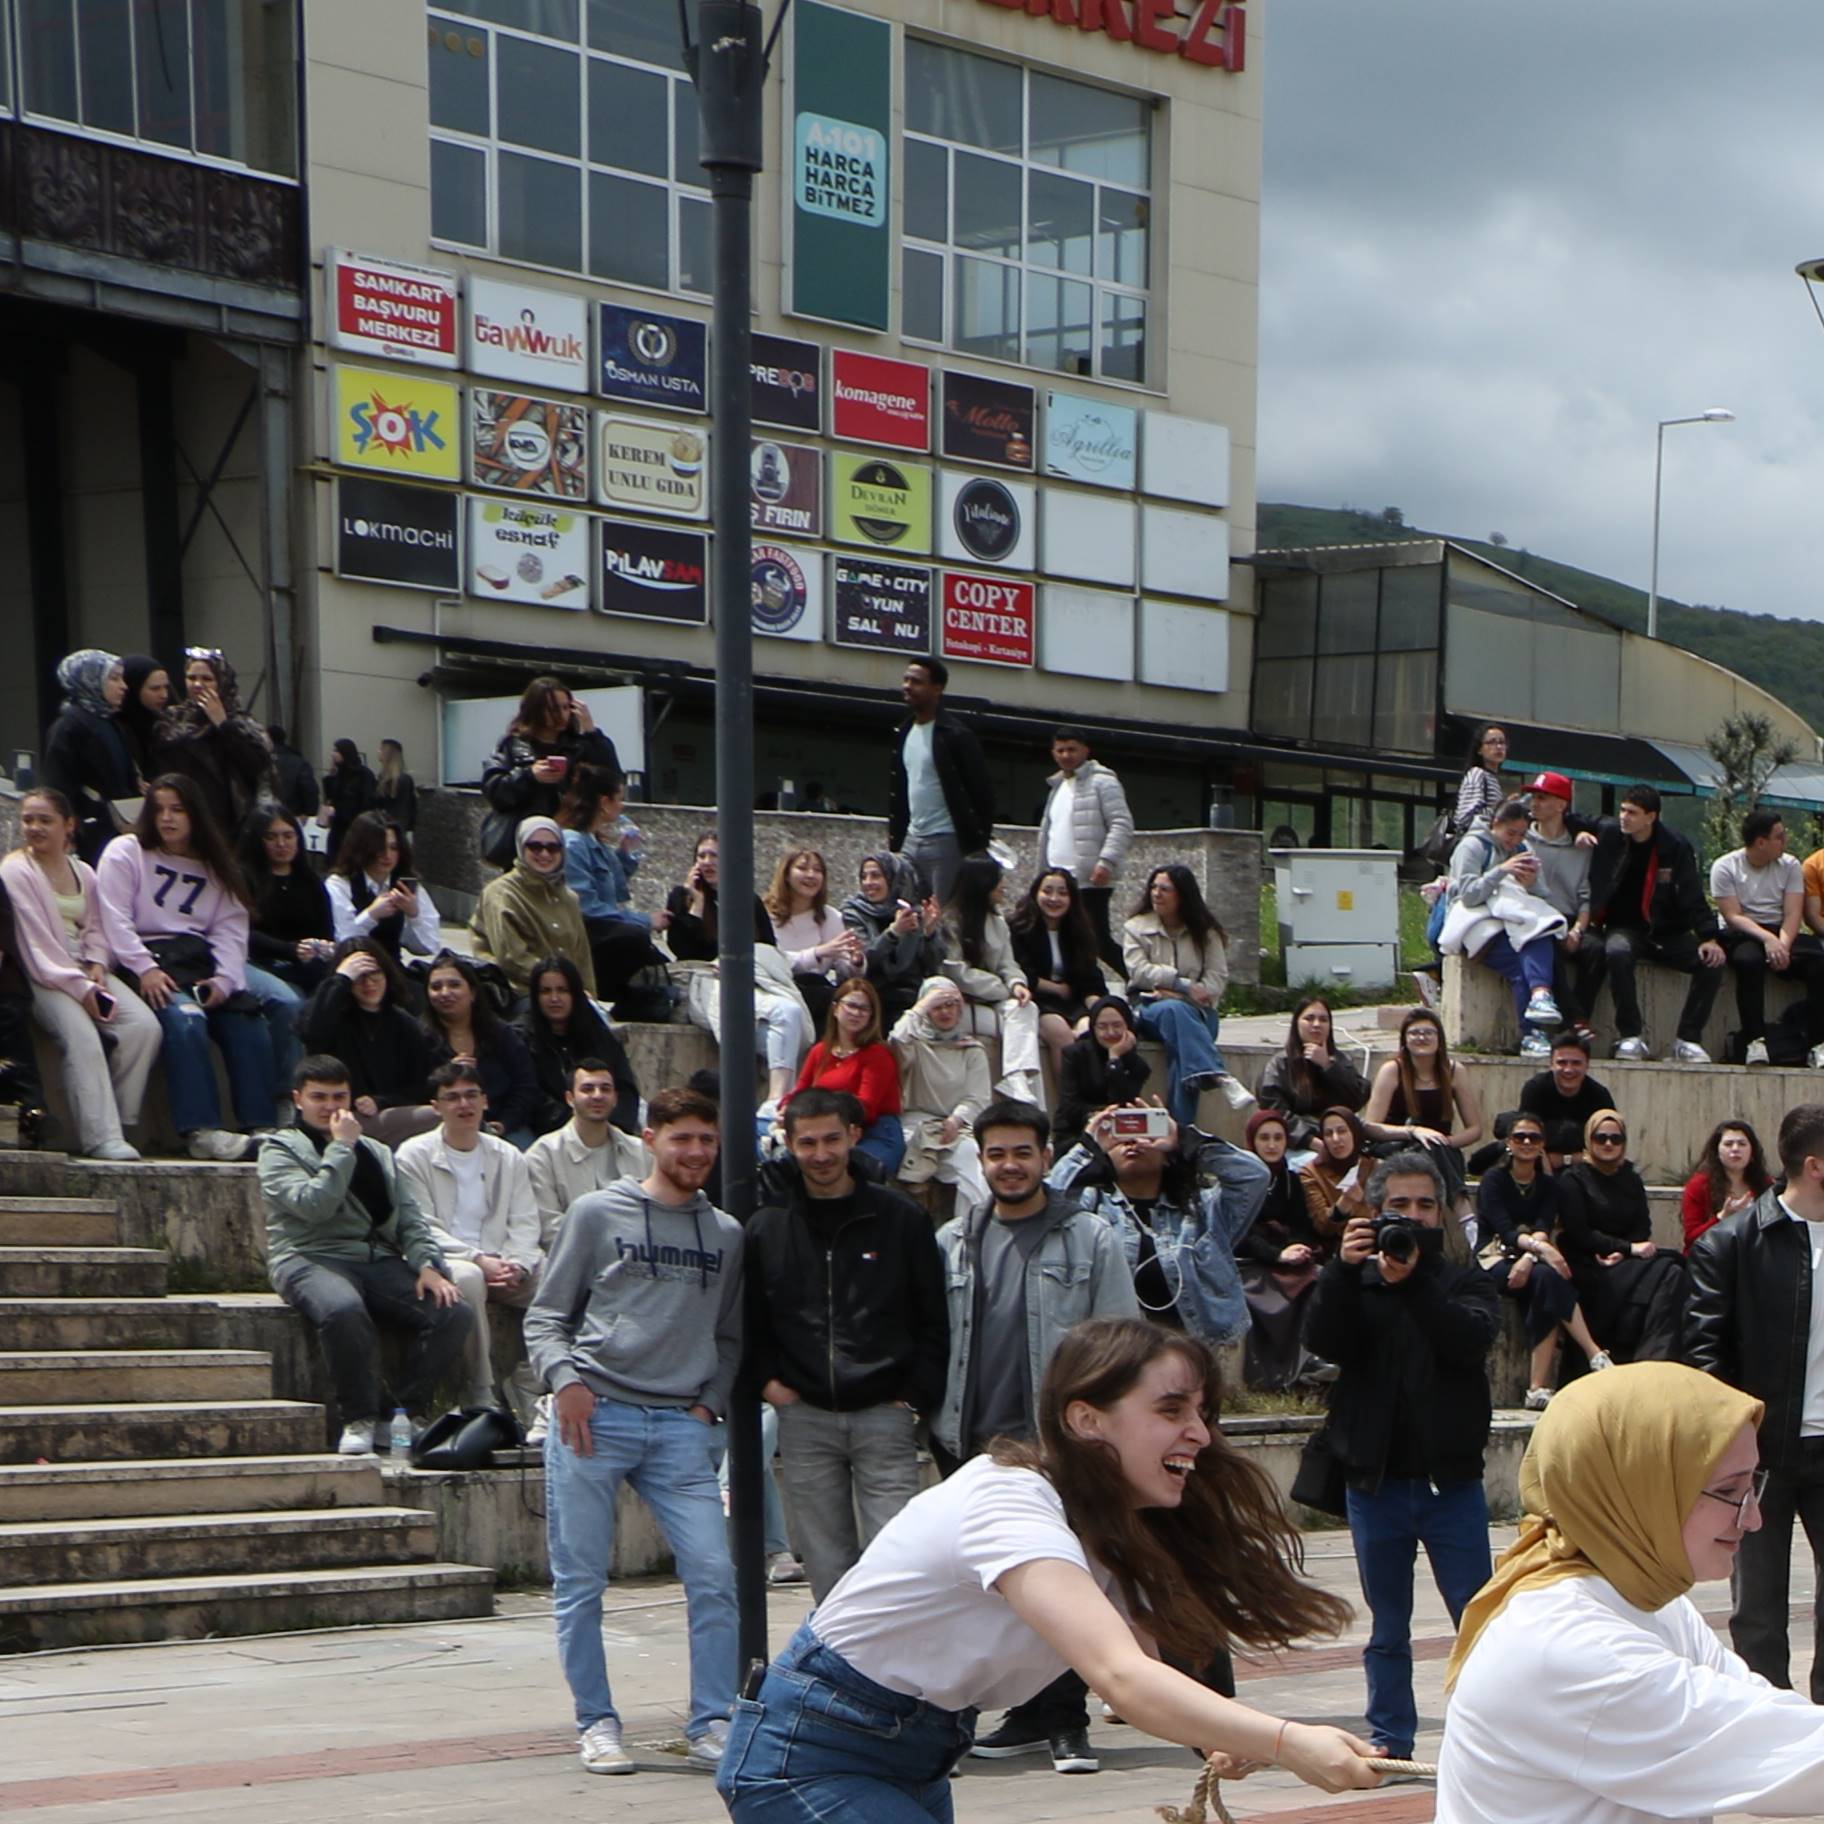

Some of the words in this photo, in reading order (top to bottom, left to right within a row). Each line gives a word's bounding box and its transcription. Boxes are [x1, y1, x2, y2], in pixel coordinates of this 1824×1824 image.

[805, 146, 875, 180] HARCA
[805, 165, 875, 199] HARCA
[353, 271, 443, 304] SAMKART
[353, 294, 441, 325] BAŞVURU
[358, 318, 441, 347] MERKEZİ
[607, 367, 660, 387] OSMAN
[662, 378, 701, 395] USTA
[835, 379, 916, 411] komagene
[350, 402, 446, 454] ŞOK
[608, 443, 666, 467] KEREM
[608, 470, 651, 491] UNLU
[656, 479, 696, 498] GIDA
[764, 505, 811, 530] FIRIN
[495, 528, 560, 549] esnaf
[893, 577, 930, 595] CITY
[954, 580, 1021, 612] COPY
[946, 608, 1028, 638] CENTER
[154, 864, 207, 915] 77
[615, 1236, 723, 1274] hummel
